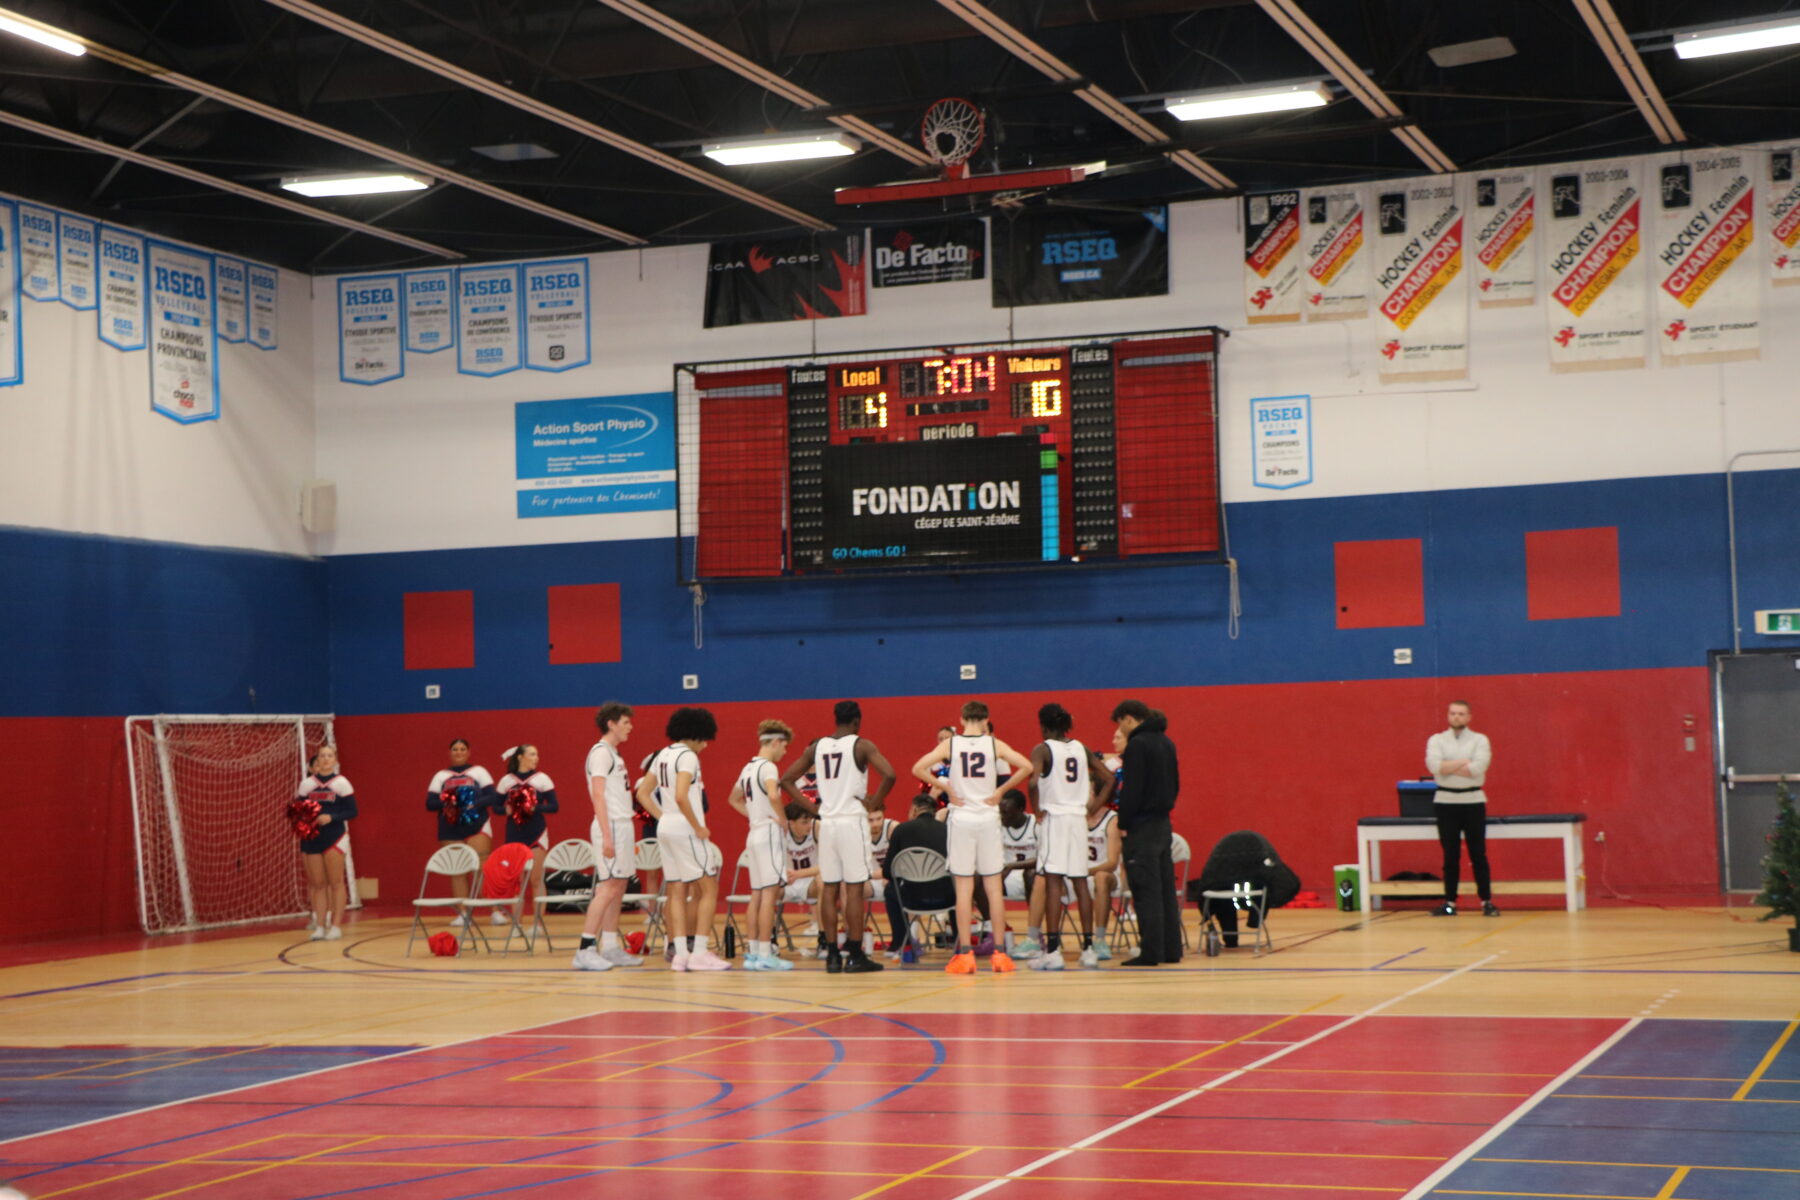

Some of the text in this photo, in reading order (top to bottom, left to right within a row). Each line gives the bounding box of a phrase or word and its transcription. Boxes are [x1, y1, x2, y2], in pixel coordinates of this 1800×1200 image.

[1270, 194, 1297, 206] 1992
[22, 213, 52, 233] RSEQ
[63, 224, 91, 244] RSEQ
[1477, 208, 1509, 244] HOCKEY
[1481, 206, 1532, 262] CHAMPION
[1041, 237, 1119, 264] RSEQ
[1254, 217, 1297, 263] CHAMPIONS
[1308, 225, 1338, 259] HOCKEY
[1313, 222, 1361, 276] CHAMPION
[1551, 222, 1599, 275] HOCKEY
[1660, 211, 1710, 265] HOCKEY
[1669, 208, 1749, 292] CHAMPION
[103, 239, 139, 264] RSEQ
[776, 254, 820, 265] ACSC
[876, 247, 906, 270] De
[910, 242, 968, 267] Facto
[1377, 237, 1424, 289] HOCKEY
[1559, 218, 1635, 301] CHAMPION
[155, 266, 207, 300] RSEQ
[410, 280, 446, 294] RSEQ
[464, 278, 513, 297] RSEQ
[531, 272, 581, 292] RSEQ
[1386, 236, 1458, 315] CHAMPION
[156, 294, 206, 315] VOLLEYBALL
[345, 287, 394, 306] RSEQ
[468, 317, 508, 328] CHAMPIONS
[160, 327, 204, 347] CHAMPIONS
[157, 342, 207, 362] PROVINCIAUX
[842, 366, 880, 388] Local
[923, 355, 996, 395] 7:04
[1007, 356, 1061, 374] Visiteurs
[865, 391, 887, 428] 4
[1258, 407, 1304, 422] RSEQ
[533, 417, 646, 436] Action Sport Physio
[568, 436, 598, 447] sportive
[532, 494, 549, 506] Fier
[552, 493, 593, 509] partenaire
[914, 513, 1020, 529] CÉGEP DE SAINT-JÉRÔME
[832, 547, 848, 560] GO
[849, 546, 883, 558] Chems
[659, 763, 669, 788] 11
[823, 752, 843, 779] 17
[960, 752, 986, 778] 12
[1065, 757, 1078, 783] 9
